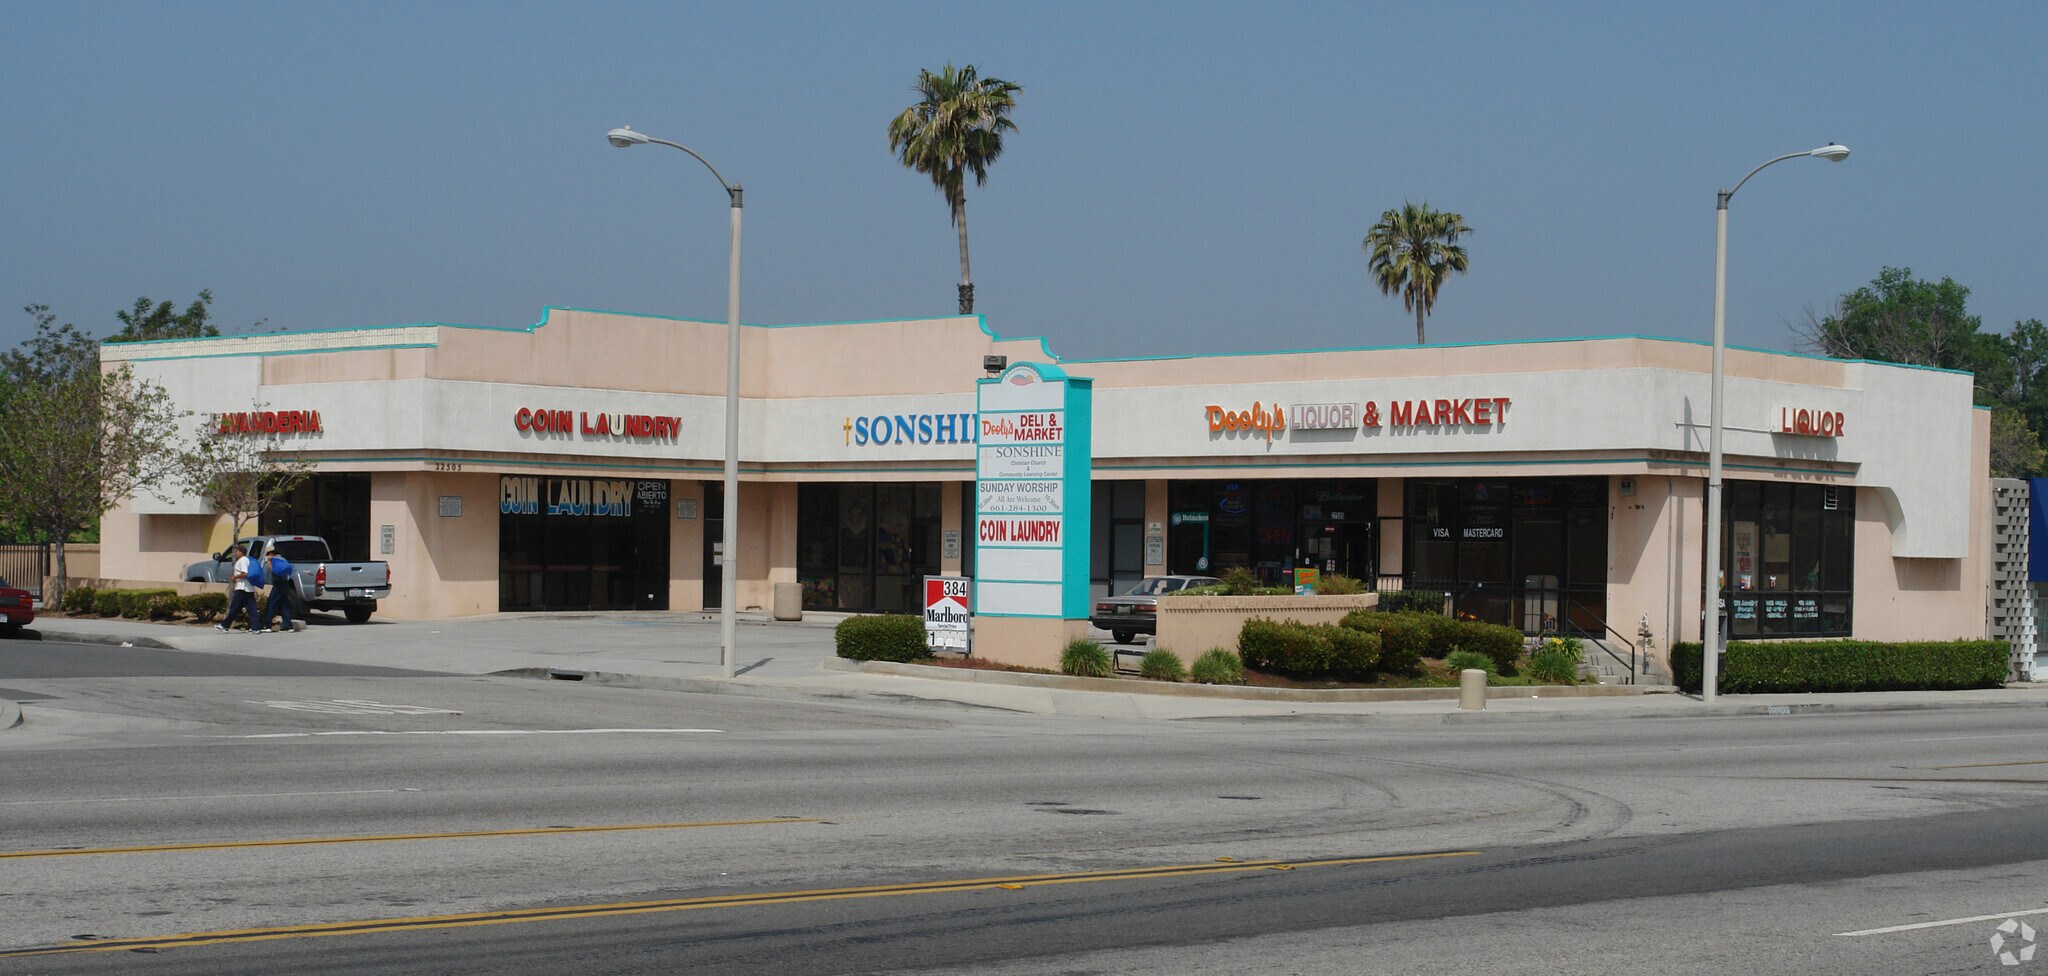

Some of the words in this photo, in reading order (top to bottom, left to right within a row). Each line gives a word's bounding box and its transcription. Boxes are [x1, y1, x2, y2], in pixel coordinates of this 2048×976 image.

[210, 410, 322, 434] LAVANDERIA
[515, 407, 572, 433] COIN
[581, 412, 682, 438] LAUNDRY
[1020, 414, 1043, 427] DELI
[1048, 413, 1057, 427] &
[1206, 401, 1285, 443] Dooly's
[1292, 405, 1353, 429] LIQUOR
[1363, 401, 1380, 426] &
[1391, 397, 1510, 426] MARKET
[1782, 407, 1844, 437] LIQUOR
[981, 418, 1014, 439] Dooly's
[1014, 428, 1063, 441] MARKET
[996, 446, 1062, 458] SONSHINE
[638, 482, 667, 491] OPEN
[980, 483, 1014, 492] SUNDAY
[1017, 483, 1058, 492] WORSHIP
[500, 477, 539, 515] COIN
[547, 479, 634, 517] LAUNDRY
[637, 491, 667, 500] ABIERTO
[980, 520, 1007, 542] COIN
[1011, 521, 1060, 542] LAUNDRY
[1433, 528, 1450, 537] VISA
[1463, 528, 1503, 538] MASTERCARD
[944, 581, 966, 596] 384
